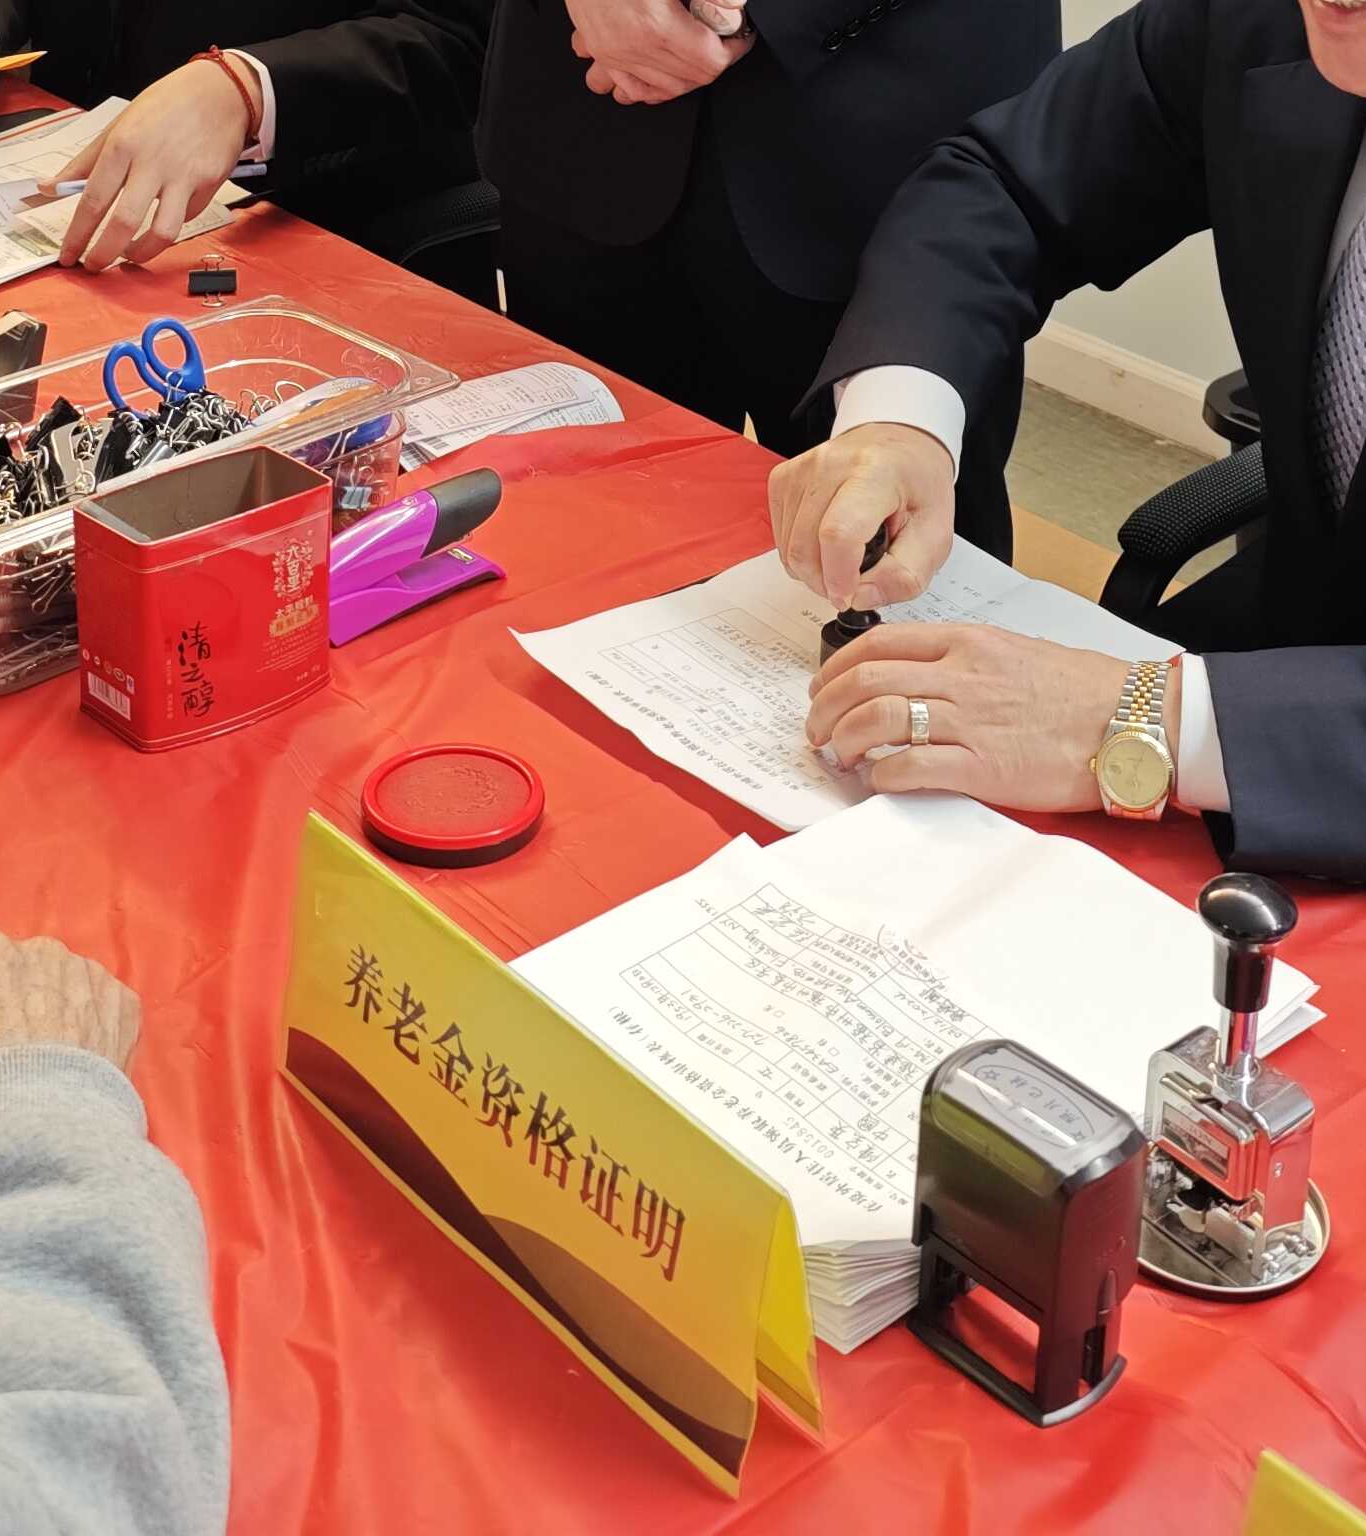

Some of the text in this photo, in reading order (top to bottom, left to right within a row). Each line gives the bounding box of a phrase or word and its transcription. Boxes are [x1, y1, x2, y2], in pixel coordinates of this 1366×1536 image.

[341, 942, 686, 1283] 养老金资格证明
